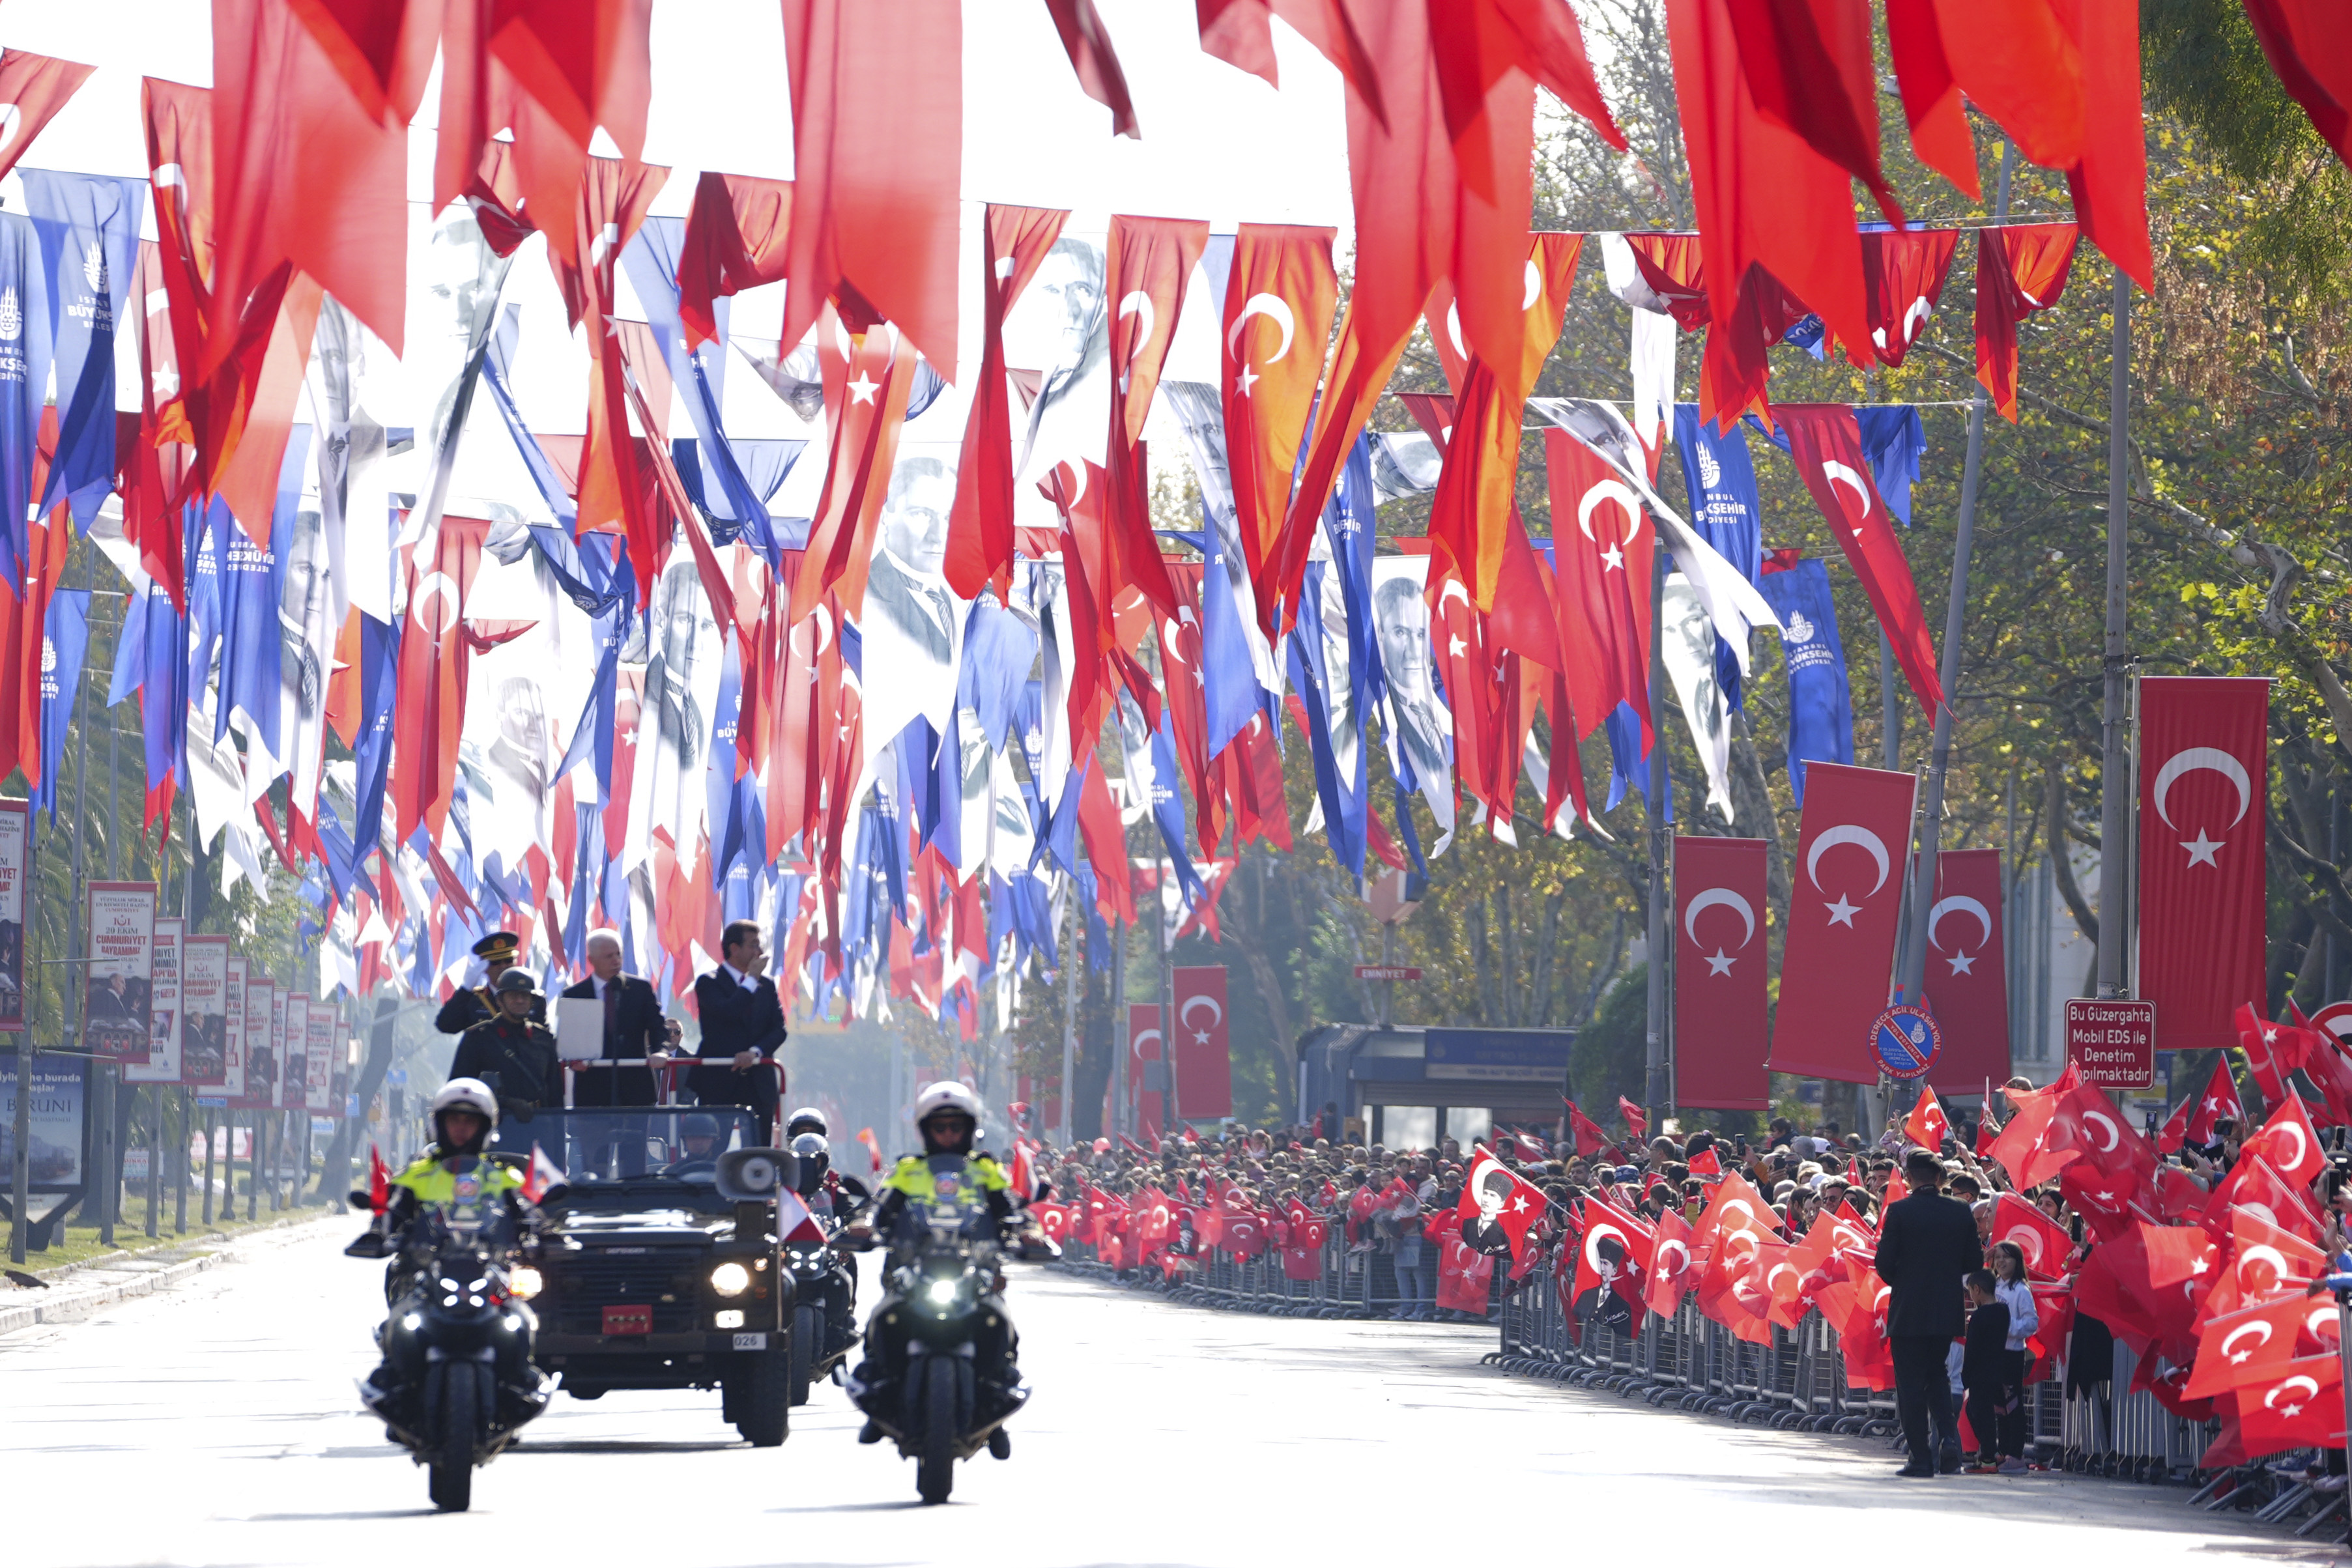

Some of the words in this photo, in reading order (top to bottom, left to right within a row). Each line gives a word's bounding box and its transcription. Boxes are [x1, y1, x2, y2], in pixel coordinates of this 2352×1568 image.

[96, 935, 147, 945] CUMHURİYET
[1362, 968, 1407, 978] EMNİYET
[2070, 1005, 2085, 1021] Bu
[2087, 1006, 2151, 1025] Güzergahta
[1891, 1005, 1908, 1016] ACİL
[1932, 1029, 1941, 1050] YOLU
[1890, 1025, 1899, 1036] YOL
[1899, 1035, 1920, 1060] BOYUNCA
[2072, 1029, 2104, 1044] Mobil
[2107, 1029, 2130, 1044] EDS
[2133, 1030, 2147, 1044] ile
[2084, 1048, 2136, 1062] Denetim
[1877, 1059, 1894, 1075] PARK
[1896, 1063, 1930, 1078] YAPILMAZ
[45, 1073, 81, 1082] burada
